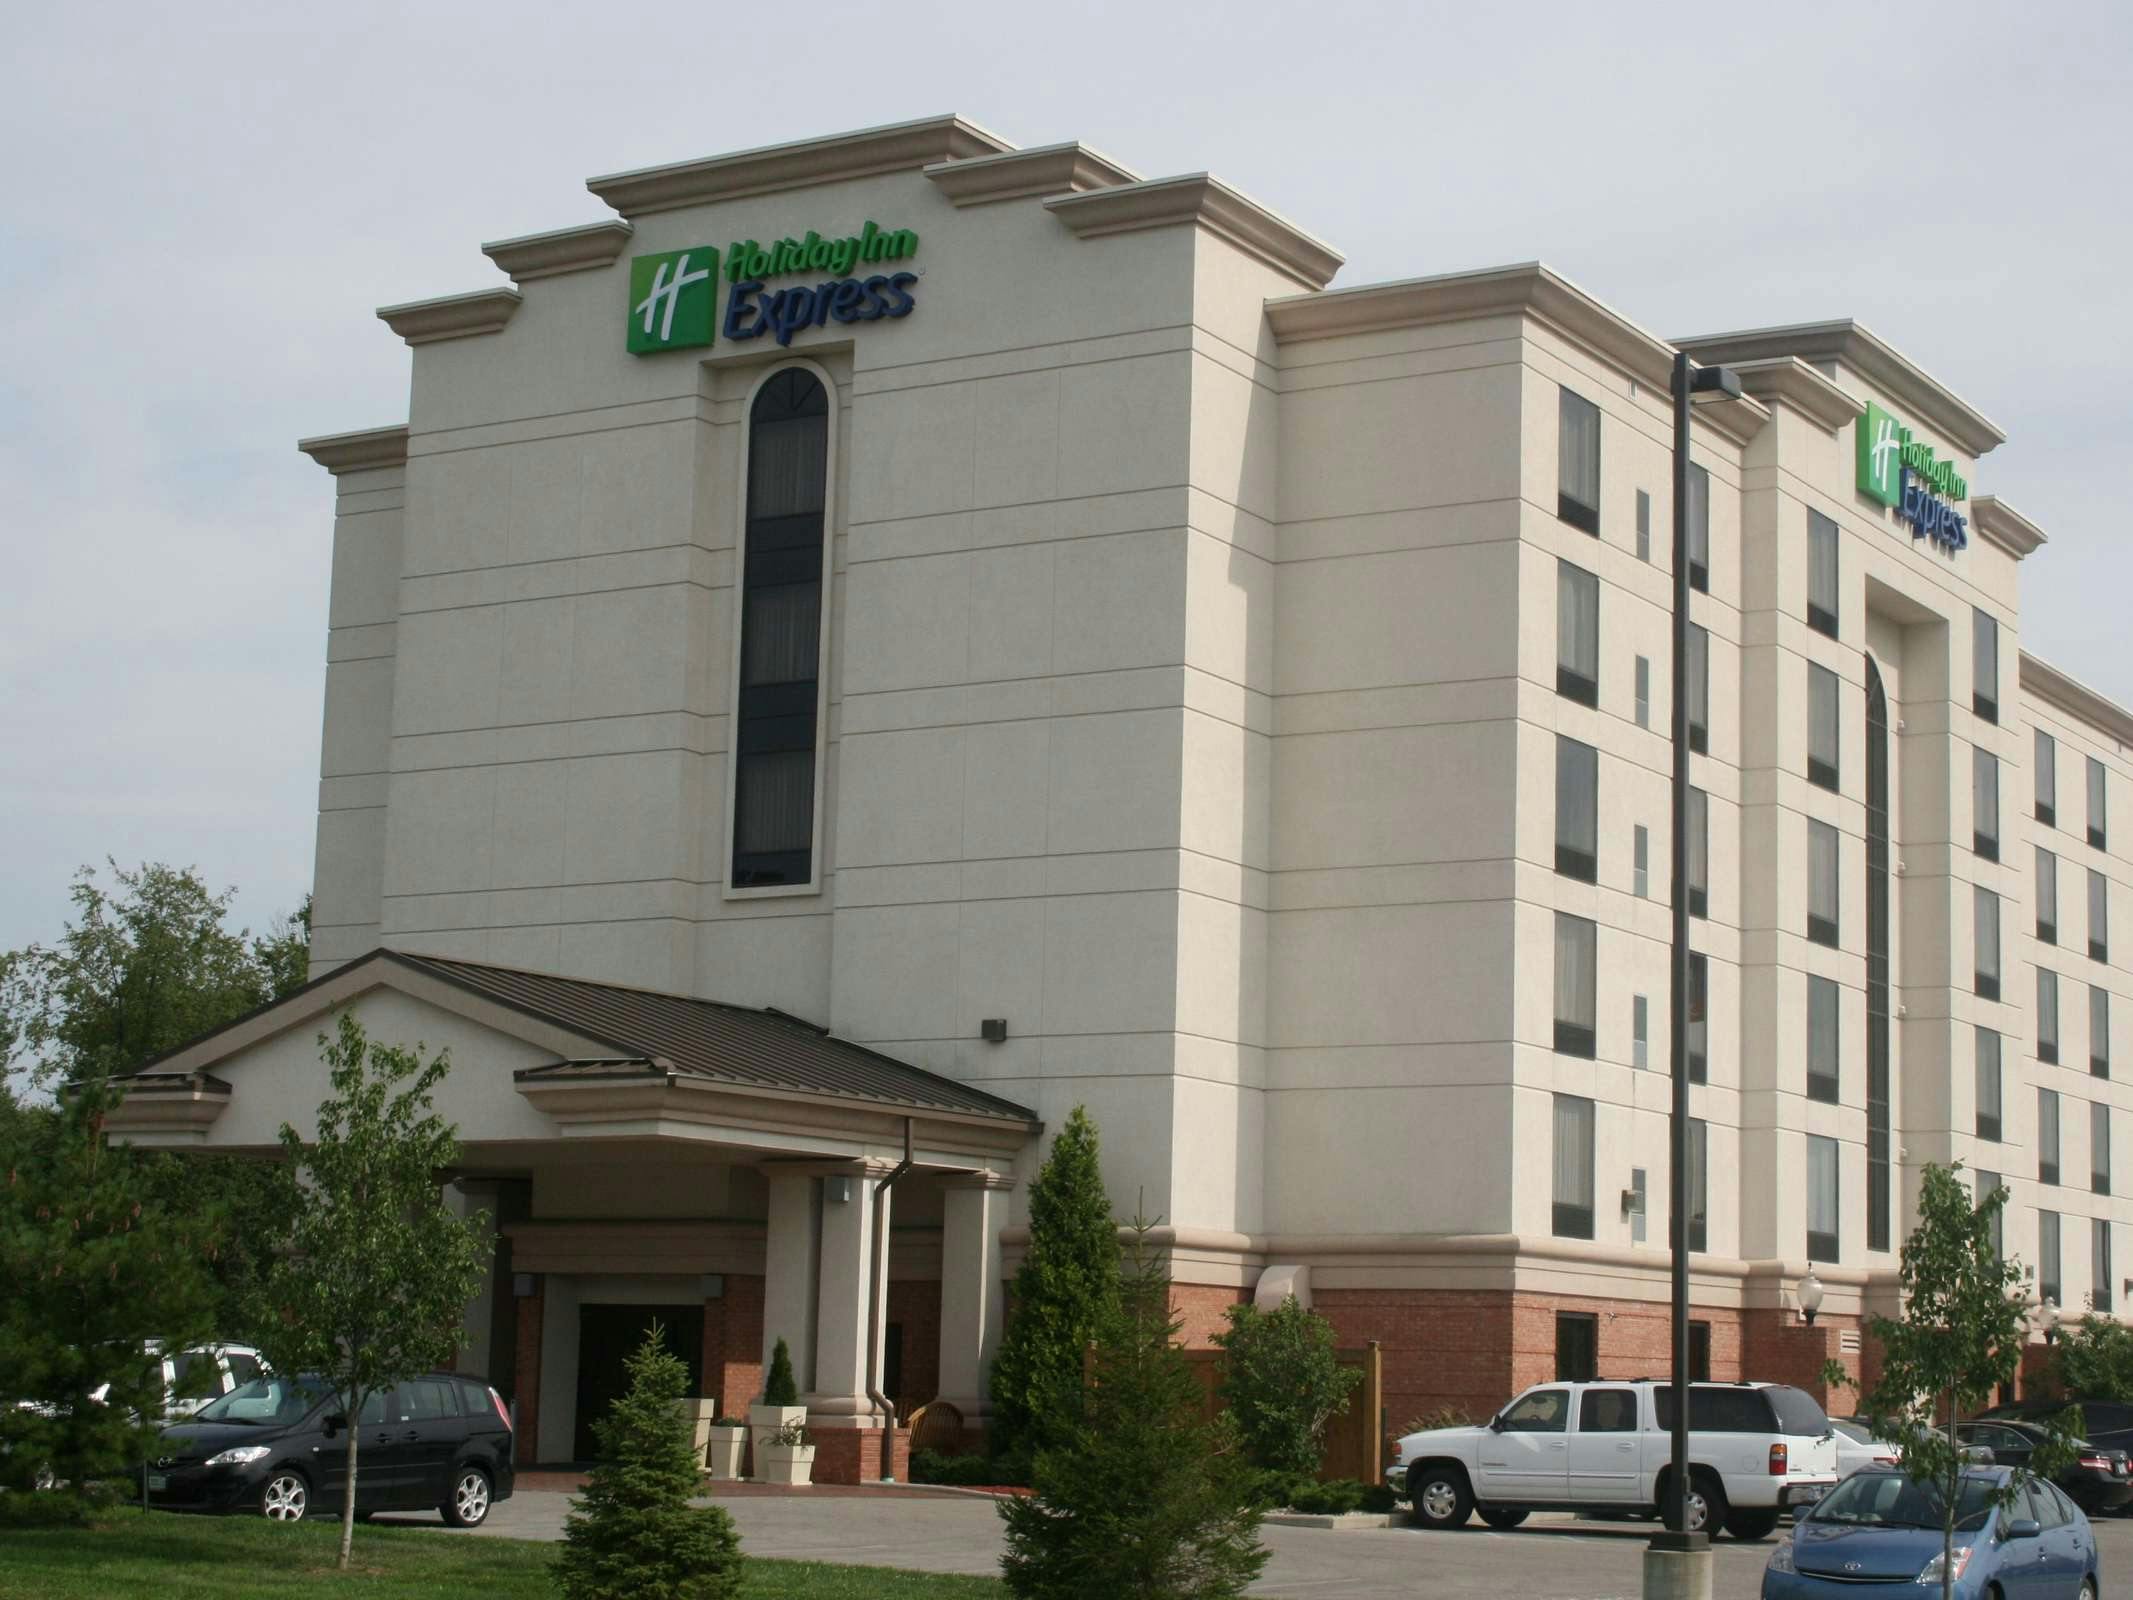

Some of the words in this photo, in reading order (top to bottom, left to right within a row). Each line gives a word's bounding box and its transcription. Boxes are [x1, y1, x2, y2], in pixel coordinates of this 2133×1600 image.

[724, 231, 859, 281] Holiday
[858, 220, 918, 261] Inn
[635, 254, 709, 341] H
[723, 271, 918, 347] Express
[1900, 428, 1953, 493] Holiday
[1951, 472, 1967, 501] Inn
[1901, 468, 1968, 550] Express
